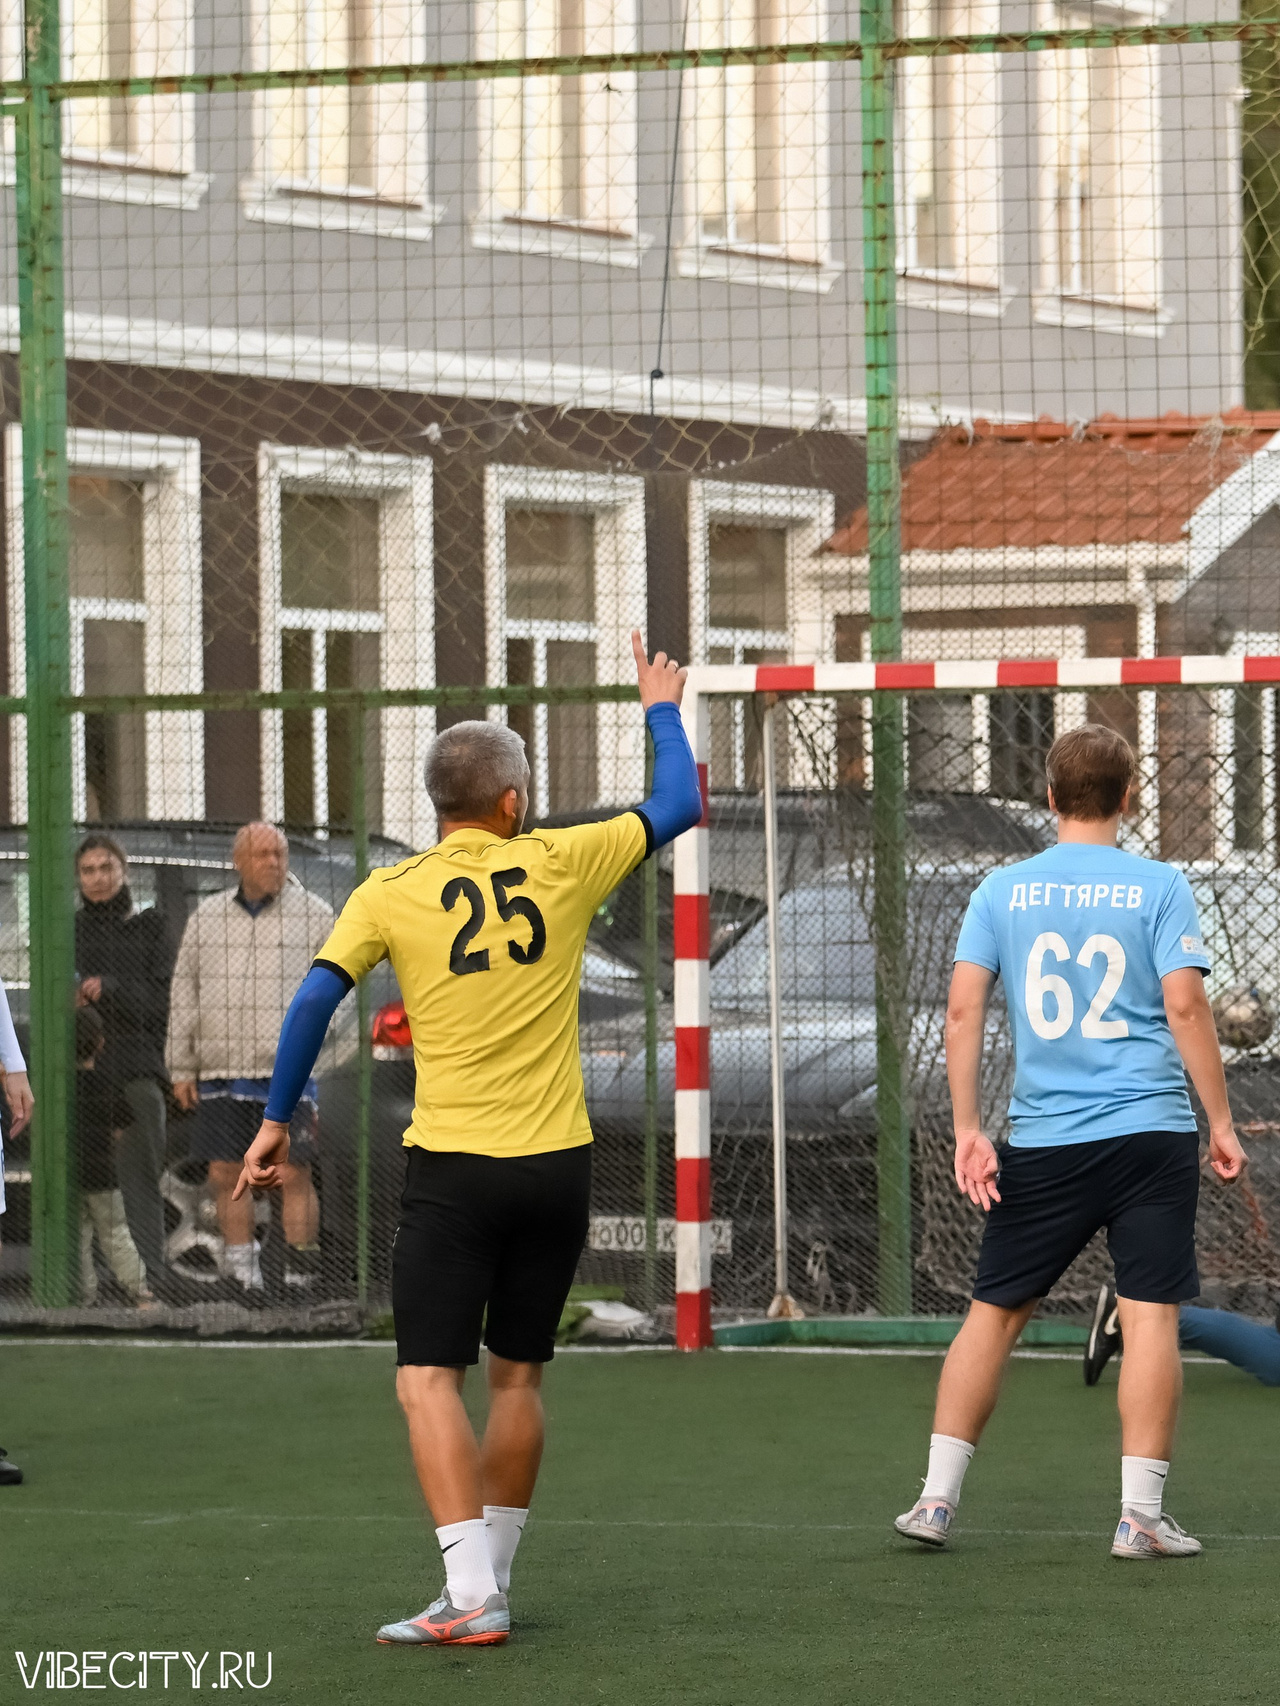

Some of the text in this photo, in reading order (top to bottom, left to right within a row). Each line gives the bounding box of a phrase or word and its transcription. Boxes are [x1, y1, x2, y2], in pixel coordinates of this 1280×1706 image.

[440, 866, 547, 976] 25
[1008, 881, 1144, 912] ДЕГТЯРЕВ
[1025, 931, 1130, 1040] 62
